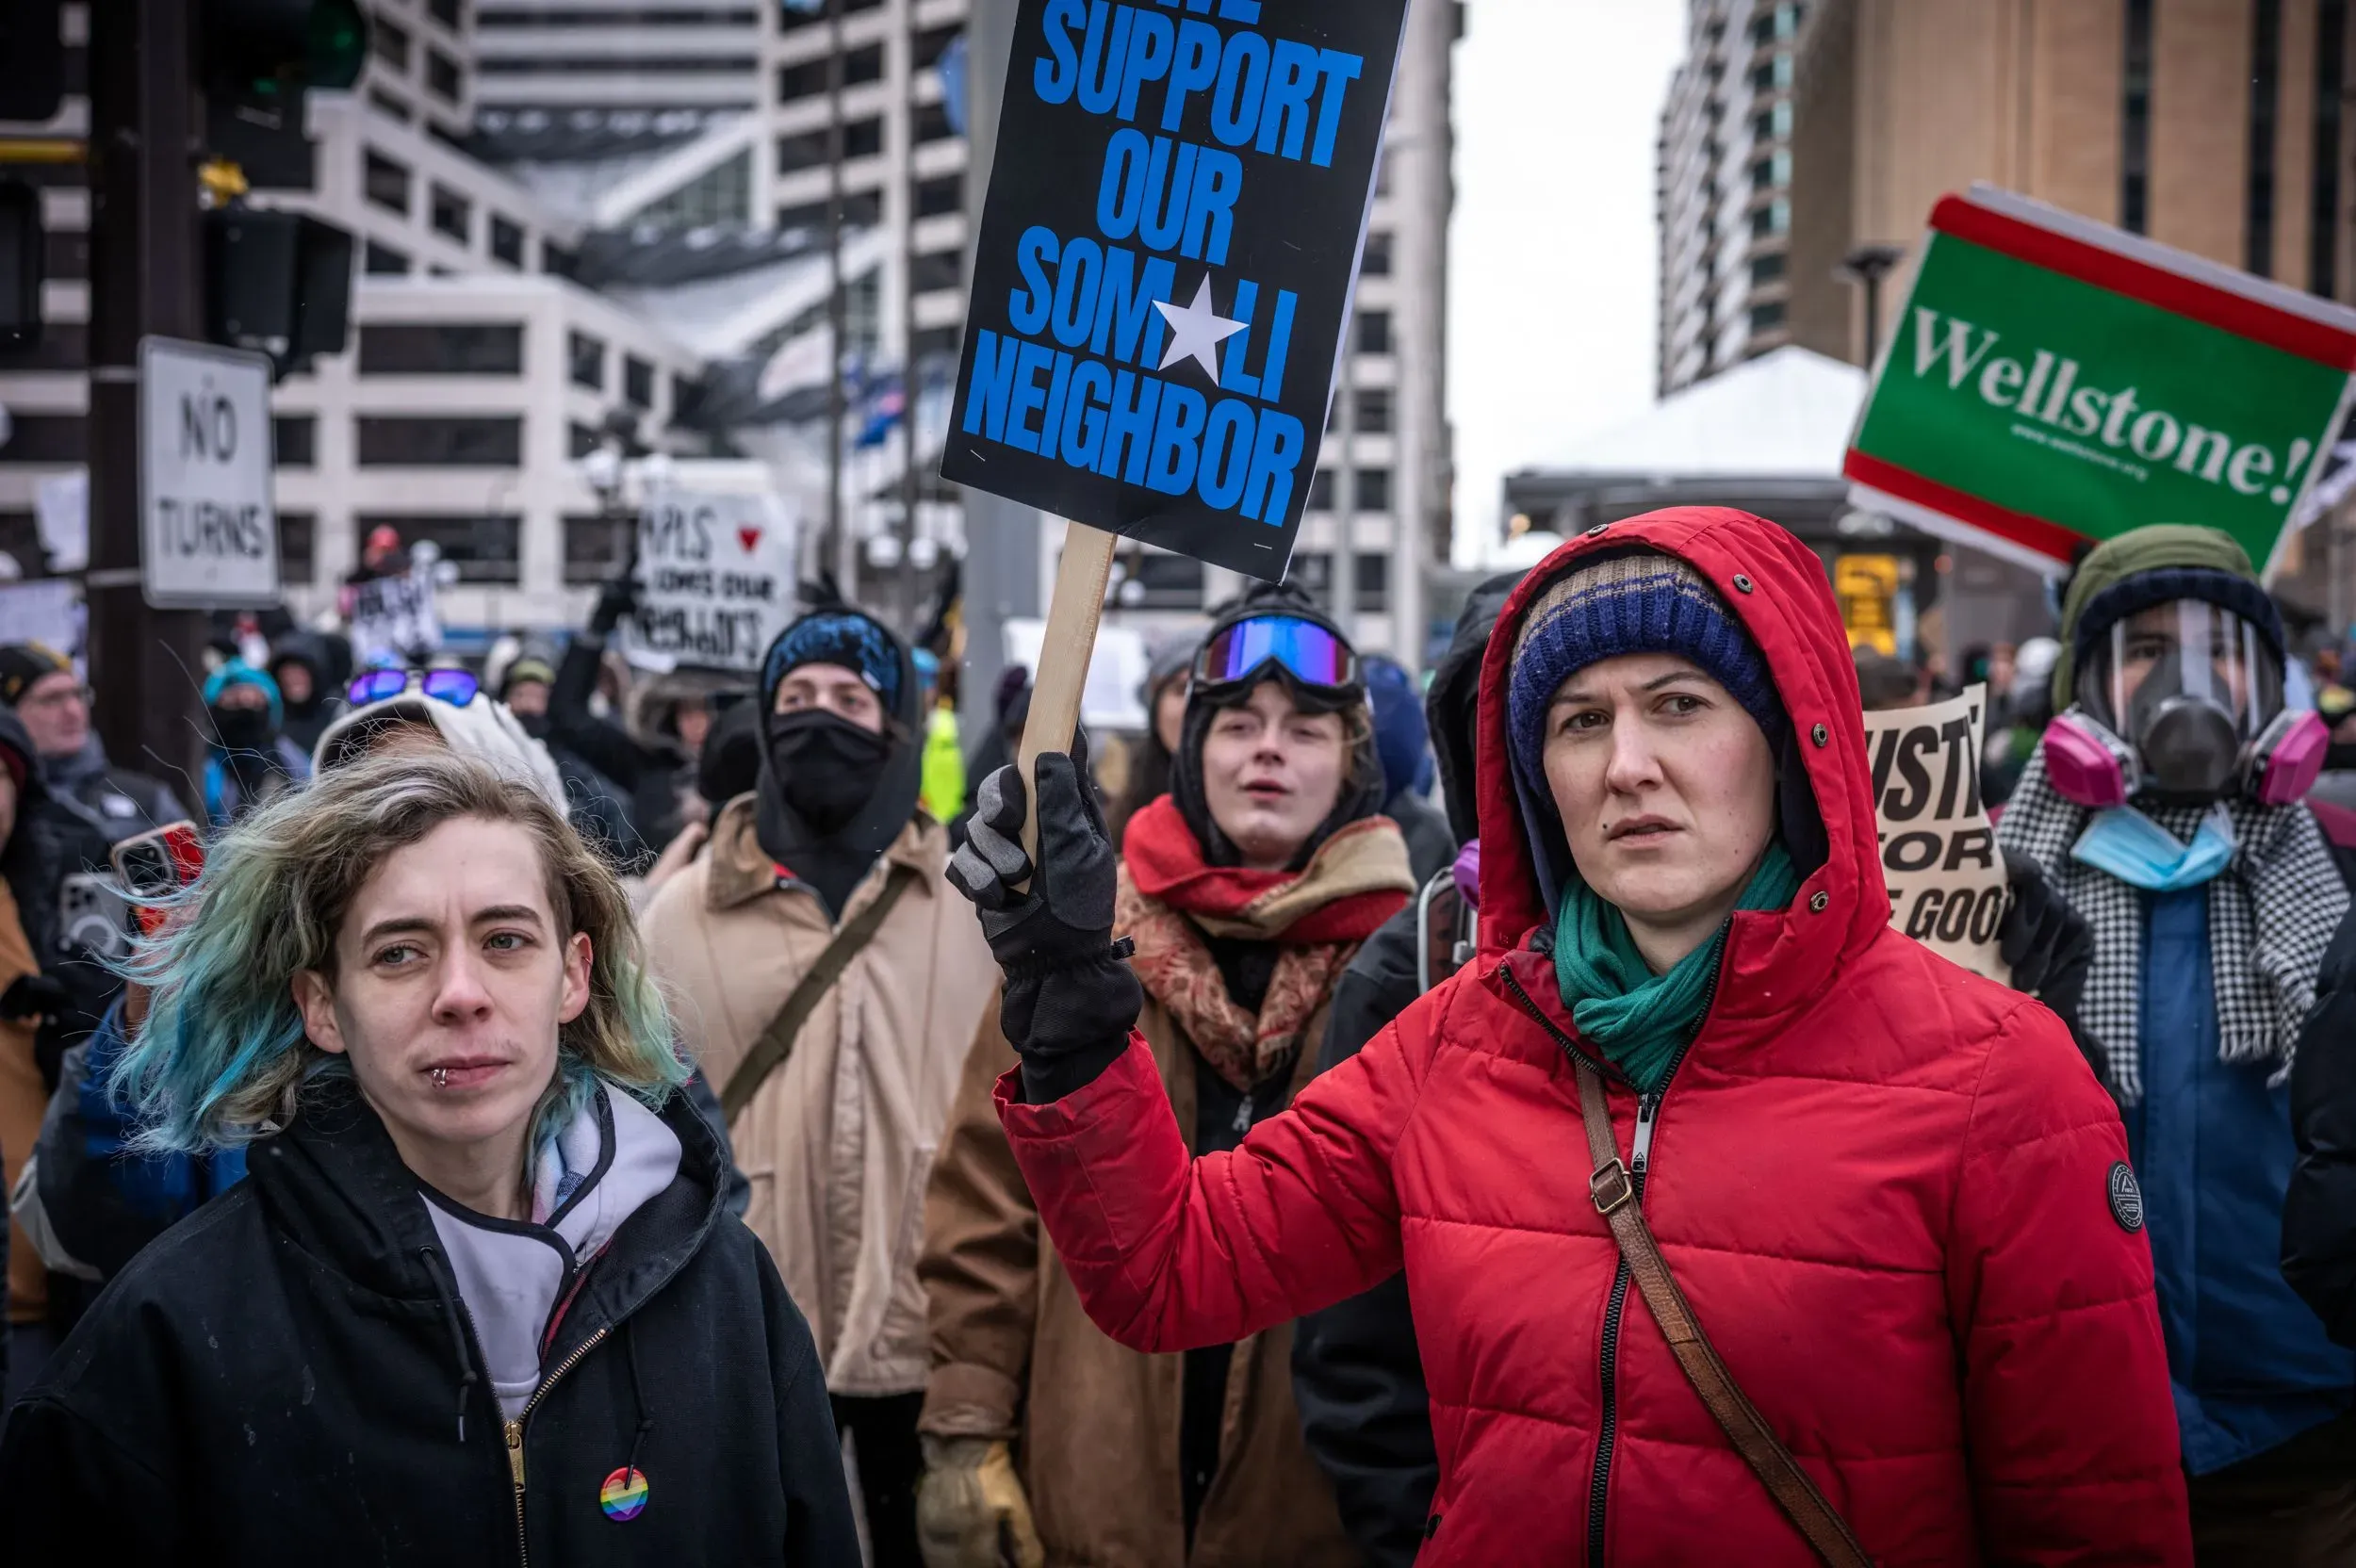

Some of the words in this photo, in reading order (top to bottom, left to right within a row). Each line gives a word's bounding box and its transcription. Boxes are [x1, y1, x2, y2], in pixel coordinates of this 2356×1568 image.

[1034, 0, 1363, 168] SUPPORT
[1097, 127, 1243, 266] OUR
[1008, 225, 1298, 403] SOMLI
[177, 394, 238, 464] NO
[962, 328, 1305, 528] NEIGHBOR
[1913, 305, 2312, 505] Wellstone!
[157, 496, 266, 560] TURNS
[1877, 828, 1994, 872] OR
[1906, 886, 2008, 945] GOO
